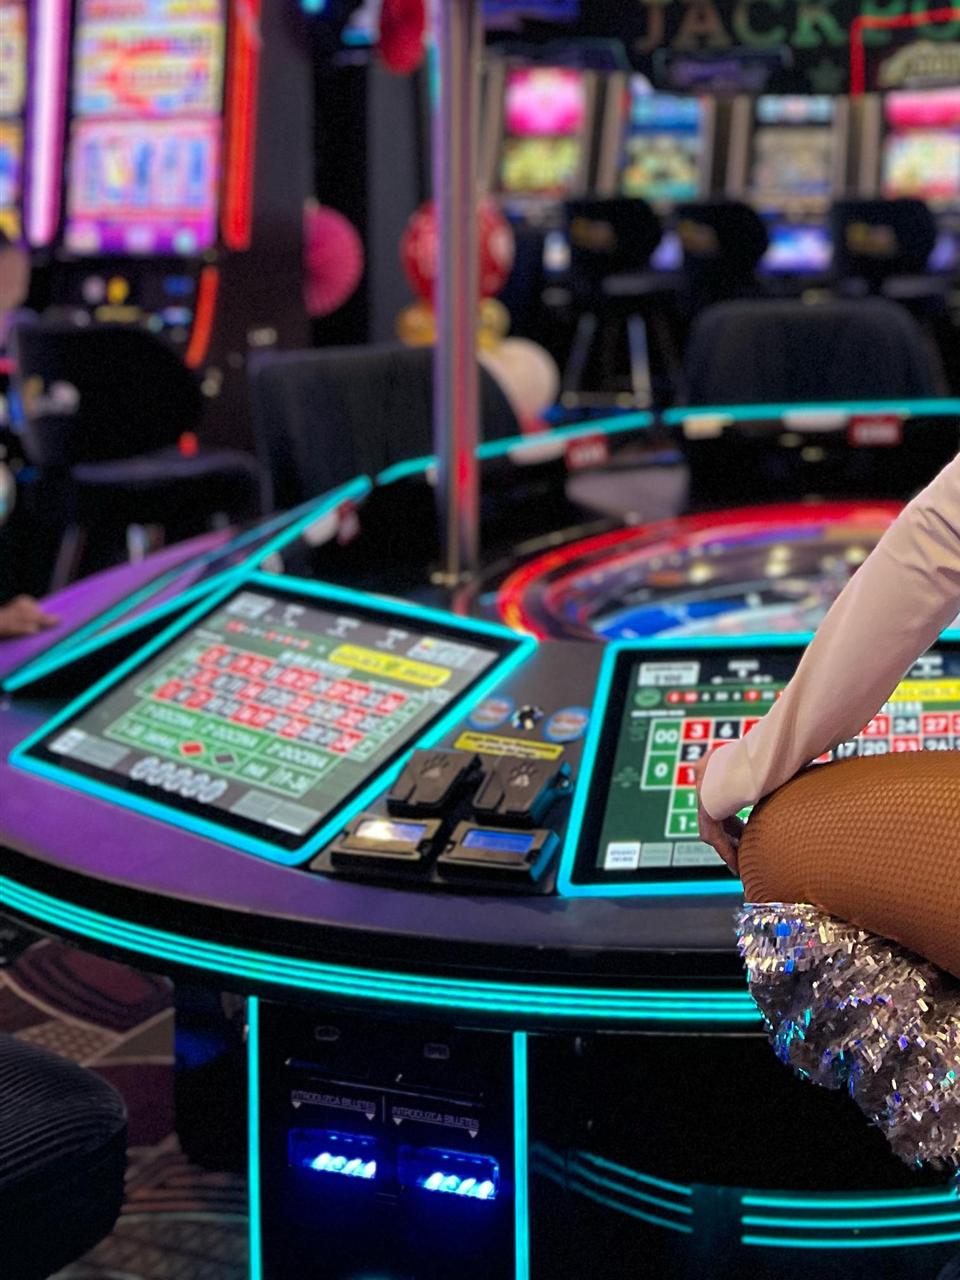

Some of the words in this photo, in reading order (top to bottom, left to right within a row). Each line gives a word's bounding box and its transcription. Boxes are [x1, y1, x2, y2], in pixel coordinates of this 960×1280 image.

[654, 729, 679, 744] 00
[690, 723, 704, 738] 3
[719, 723, 733, 737] 6
[686, 746, 701, 760] 2
[654, 763, 668, 778] 0
